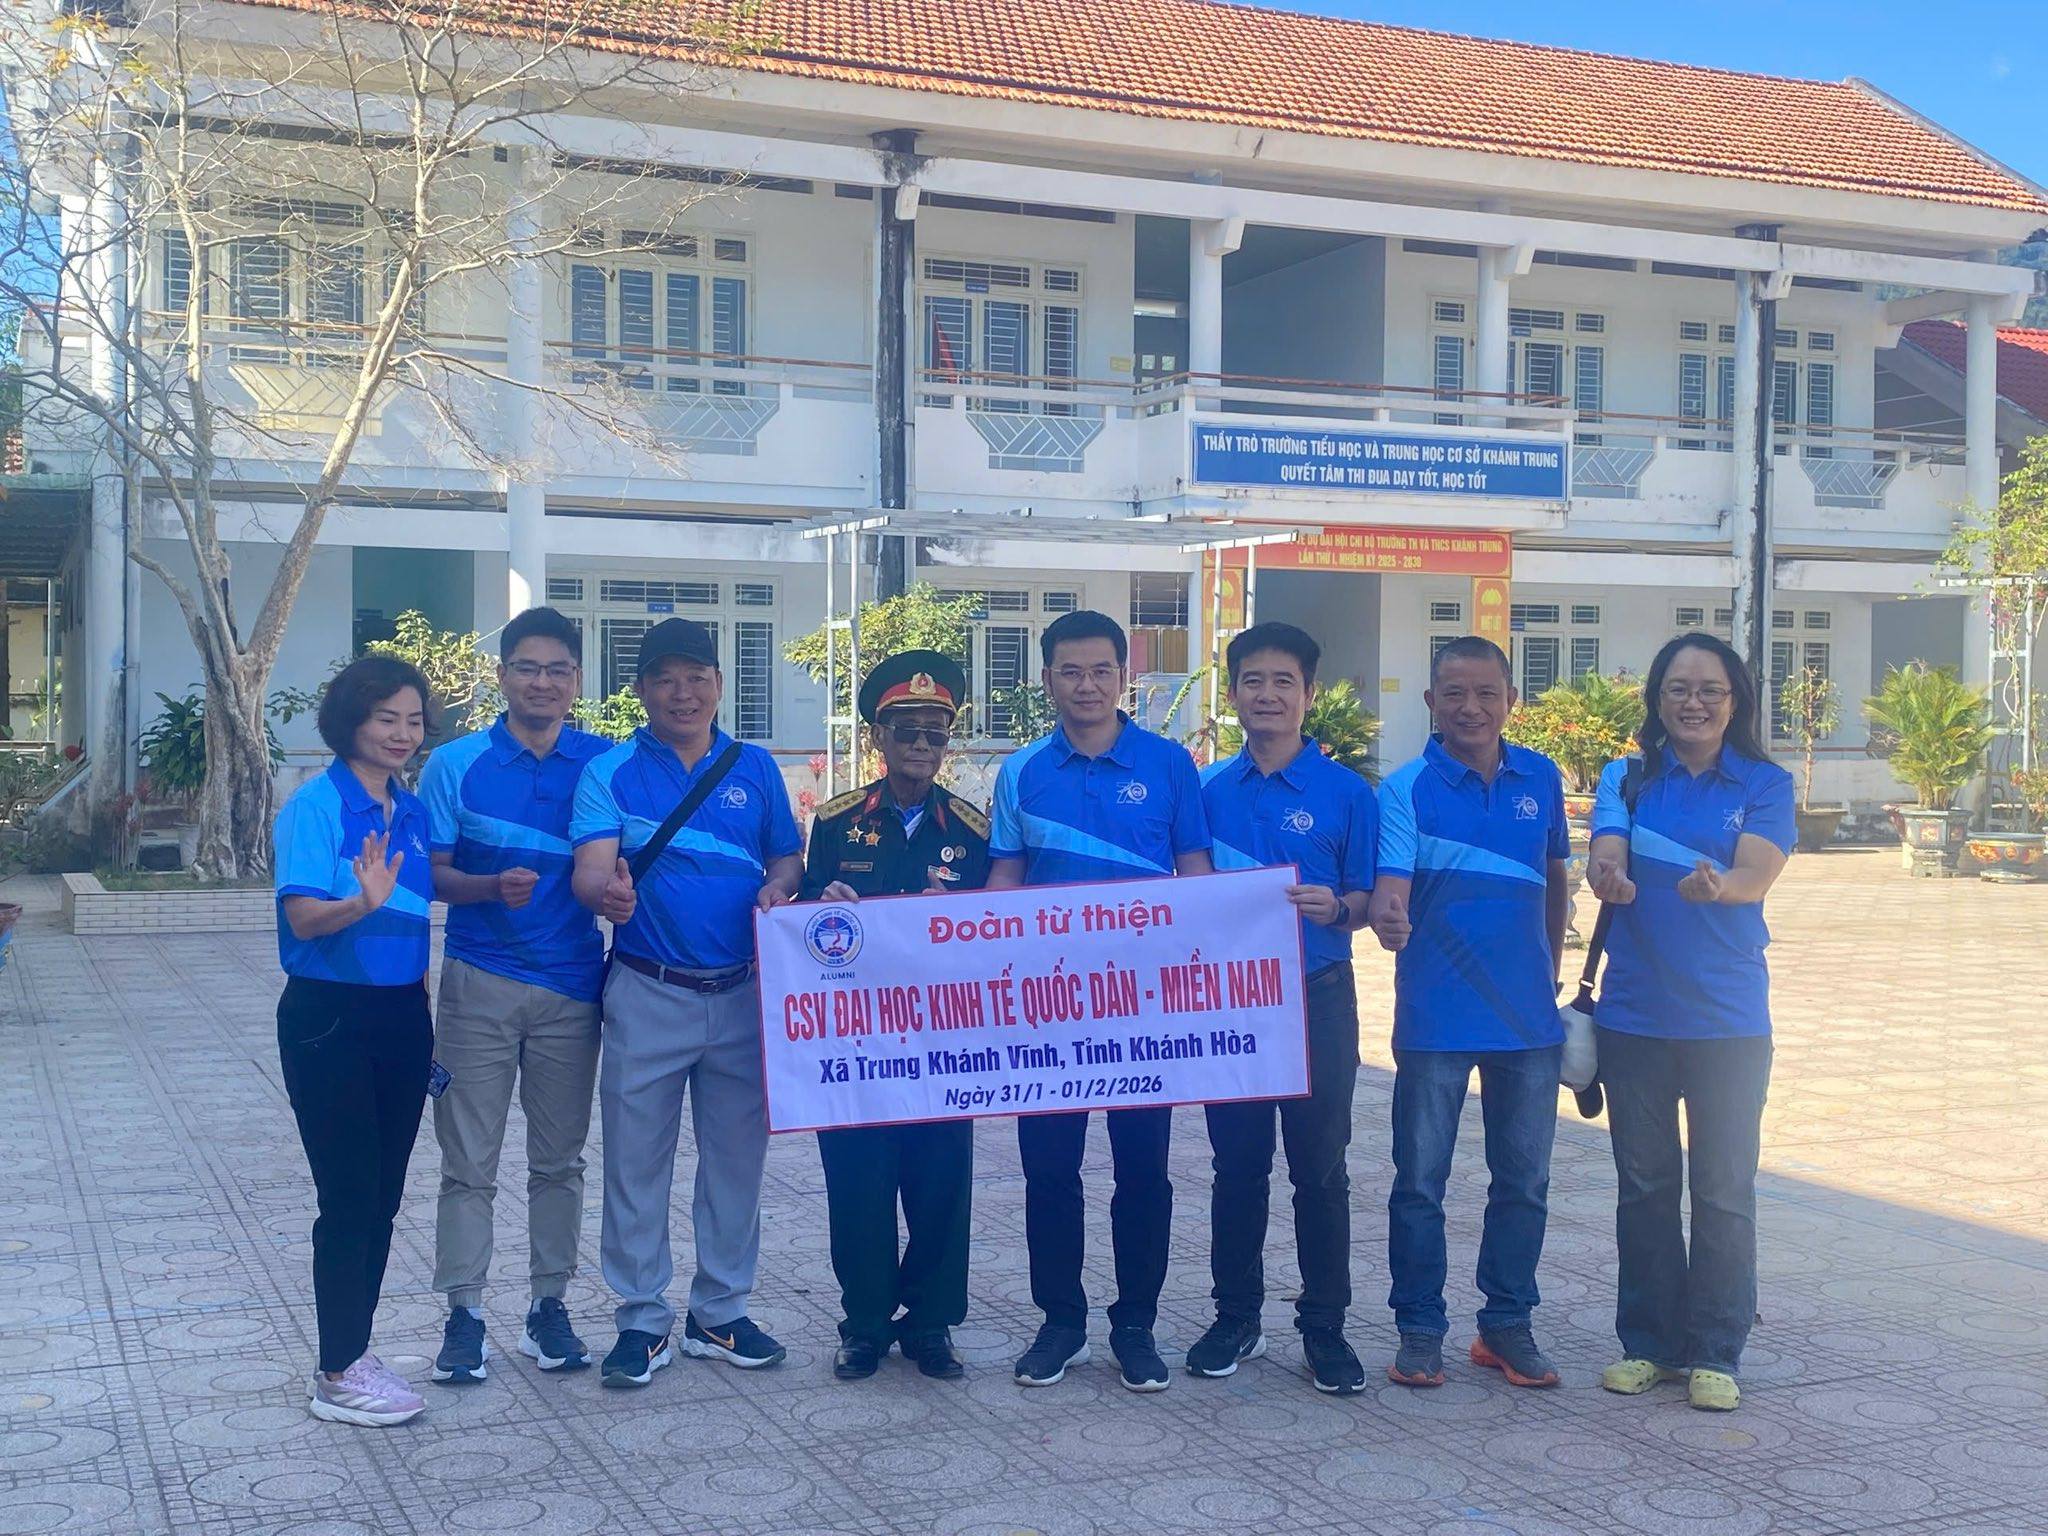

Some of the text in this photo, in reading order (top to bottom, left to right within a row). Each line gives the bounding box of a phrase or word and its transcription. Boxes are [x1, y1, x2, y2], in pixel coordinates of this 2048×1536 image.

[1236, 433, 1258, 452] TRÒ
[1261, 435, 1307, 455] TRƯỜNG
[1311, 435, 1335, 456] TIỂU
[1339, 441, 1361, 461] HỌC
[1365, 440, 1379, 459] VÀ
[1383, 444, 1419, 461] TRUNG
[1422, 446, 1444, 464] HỌC
[1447, 447, 1462, 462] CƠ
[1465, 444, 1480, 464] SỞ
[1483, 447, 1520, 466] KHÁNH
[1523, 451, 1558, 468] TRUNG
[1281, 461, 1487, 491] QUYẾT TÂM THI ĐUA DẠY TỐT, HỌC TỐT
[1350, 534, 1363, 547] CHI
[1408, 537, 1418, 550] TH
[1420, 536, 1430, 551] VÀ
[1431, 538, 1450, 552] THCS
[1451, 538, 1477, 552] KHÁNH
[1478, 540, 1503, 553] TRUNG
[1378, 554, 1396, 567] 2025
[1403, 555, 1422, 568] 2030
[928, 899, 1173, 944] Đoàn từ thiện
[820, 971, 855, 981] ALUMNI
[784, 948, 1283, 1047] CSV ĐẠI HỌC KINH TẾ QUỐC DÂN - MIỀN NAM
[819, 1029, 1257, 1084] Xã Trung Khánh Vĩnh, Tỉnh Khánh Hòa
[945, 1085, 996, 1110] Ngày
[1000, 1082, 1043, 1103] 31/1
[1061, 1075, 1163, 1099] 01/2/2026
